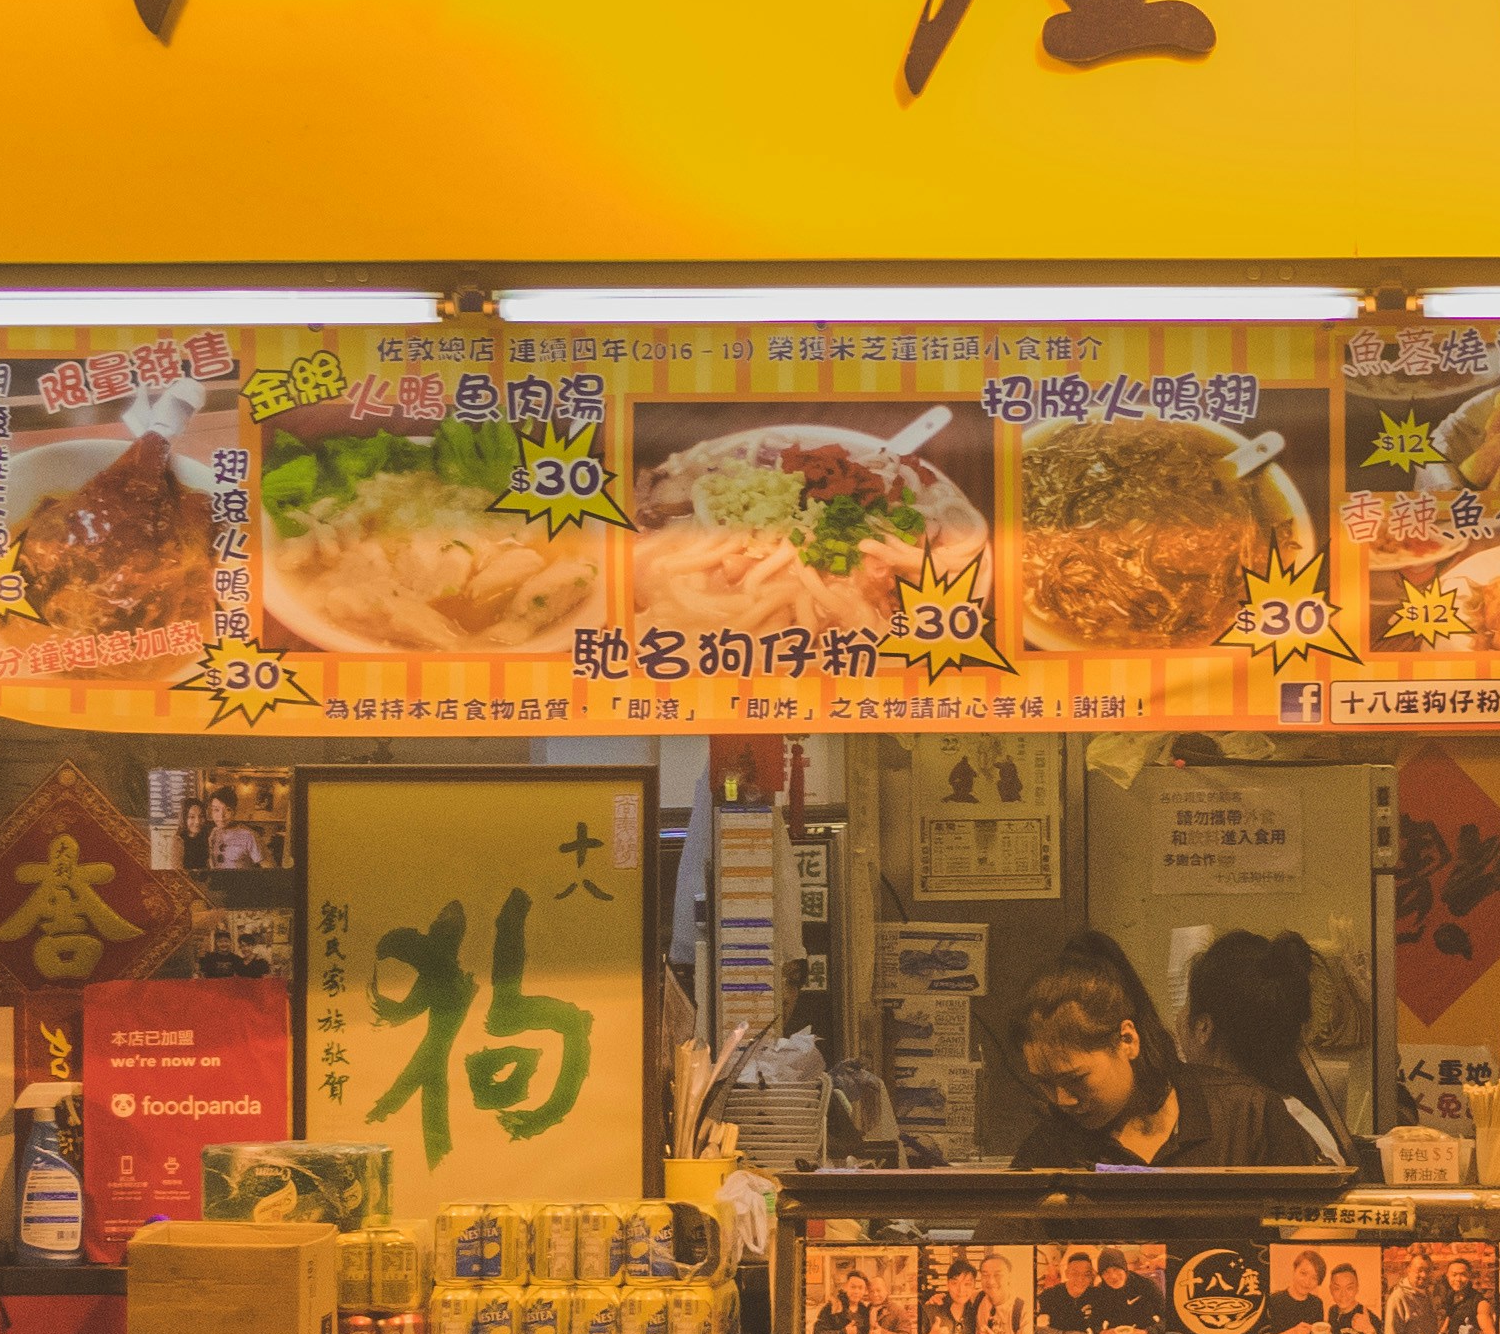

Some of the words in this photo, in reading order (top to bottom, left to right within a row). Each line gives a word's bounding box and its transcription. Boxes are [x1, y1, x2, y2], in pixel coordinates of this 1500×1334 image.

[377, 336, 495, 364] 佐敦總店
[38, 331, 235, 412] 限量發售
[983, 371, 1257, 424] 招牌火鴨翅
[1380, 431, 1425, 454] $12
[510, 459, 601, 498] $30
[890, 605, 979, 642] $30
[1235, 599, 1326, 637] $30
[1404, 602, 1449, 625] $12
[572, 627, 879, 681] 馳名狗仔粉
[206, 658, 281, 691] $30
[554, 821, 614, 903] 十八
[110, 1028, 195, 1047] 本店已加盟
[366, 887, 595, 1172] 狗
[110, 1054, 155, 1069] we're
[160, 1056, 194, 1069] now
[200, 1056, 222, 1069] on
[1397, 1059, 1492, 1085] 人重地
[142, 1094, 263, 1121] foodpanda
[1179, 1267, 1262, 1298] 十八座
